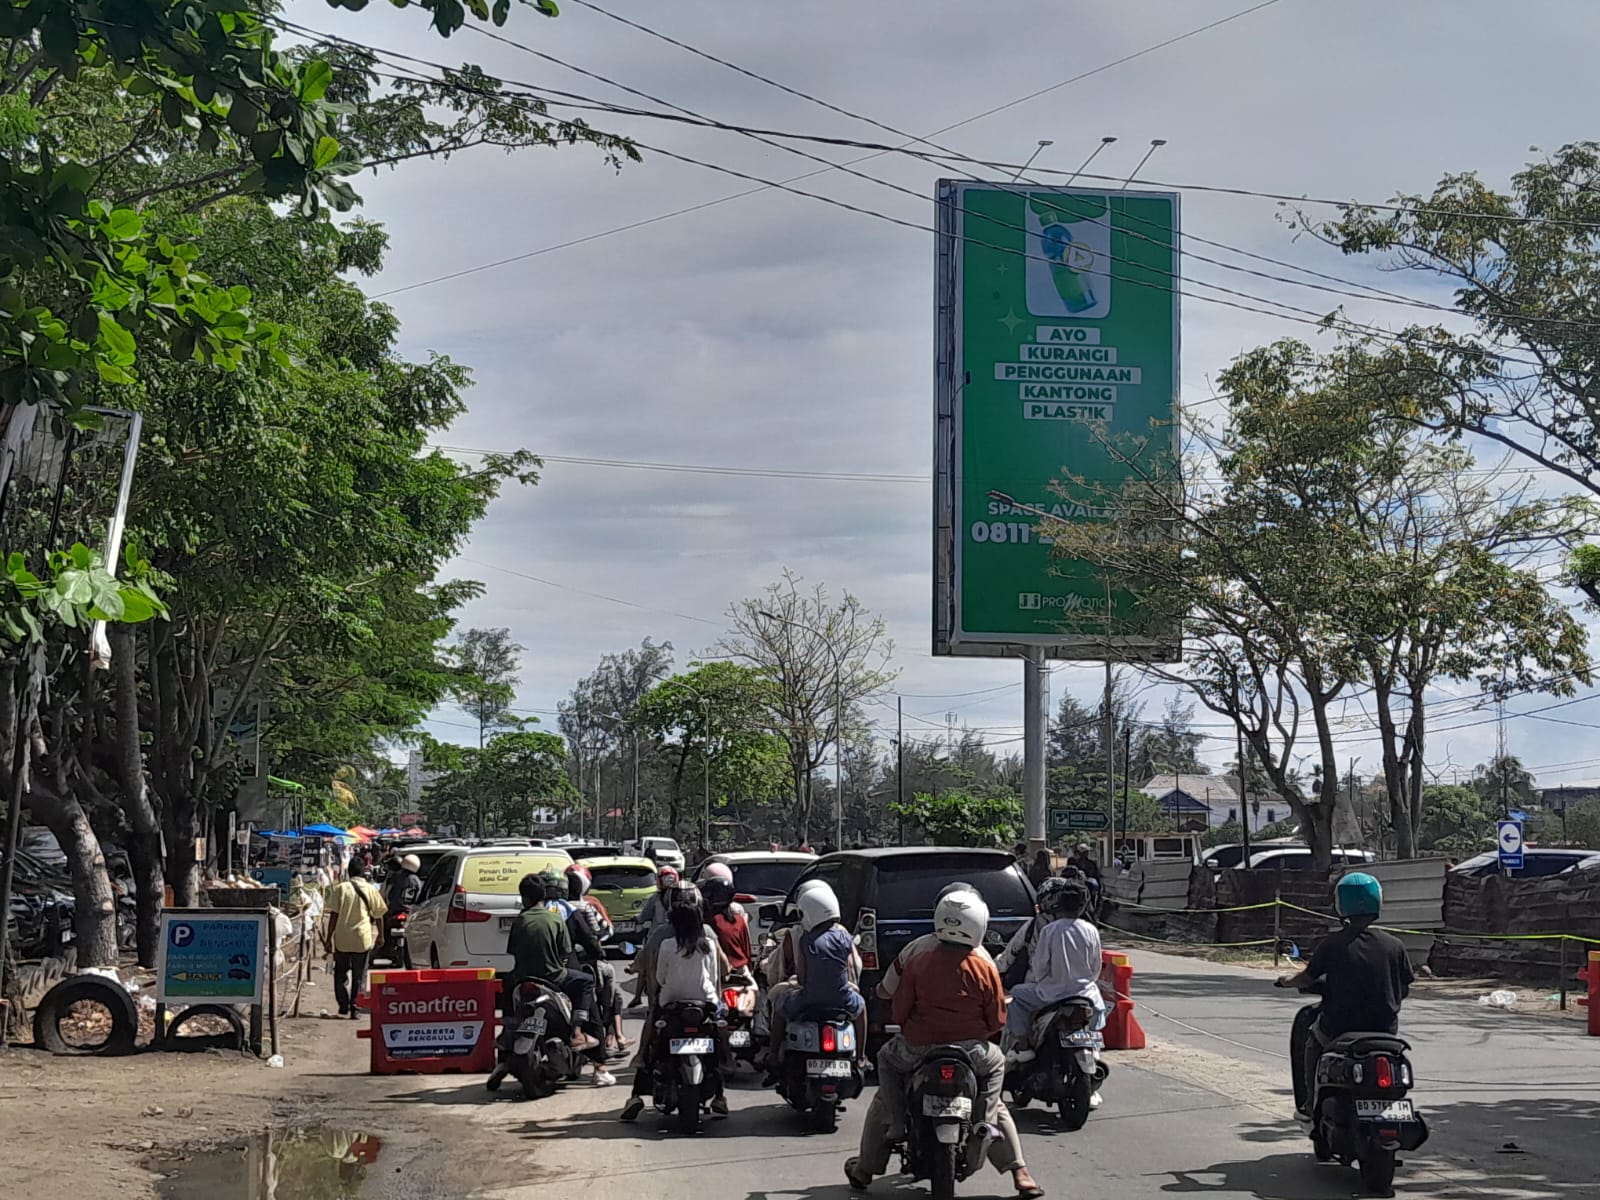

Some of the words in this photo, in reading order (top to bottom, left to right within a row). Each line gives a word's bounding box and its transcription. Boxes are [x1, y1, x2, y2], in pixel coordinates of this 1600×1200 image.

[1049, 329, 1087, 342] AYO
[1028, 347, 1109, 361] KURANGI
[1005, 365, 1131, 382] PENGGUNAAN
[1024, 385, 1113, 401] KANTONG
[1031, 404, 1106, 420] PLASTIK
[988, 501, 1046, 517] SPACE
[971, 521, 1030, 544] 0811
[175, 926, 190, 945] P
[388, 995, 478, 1015] smartfren
